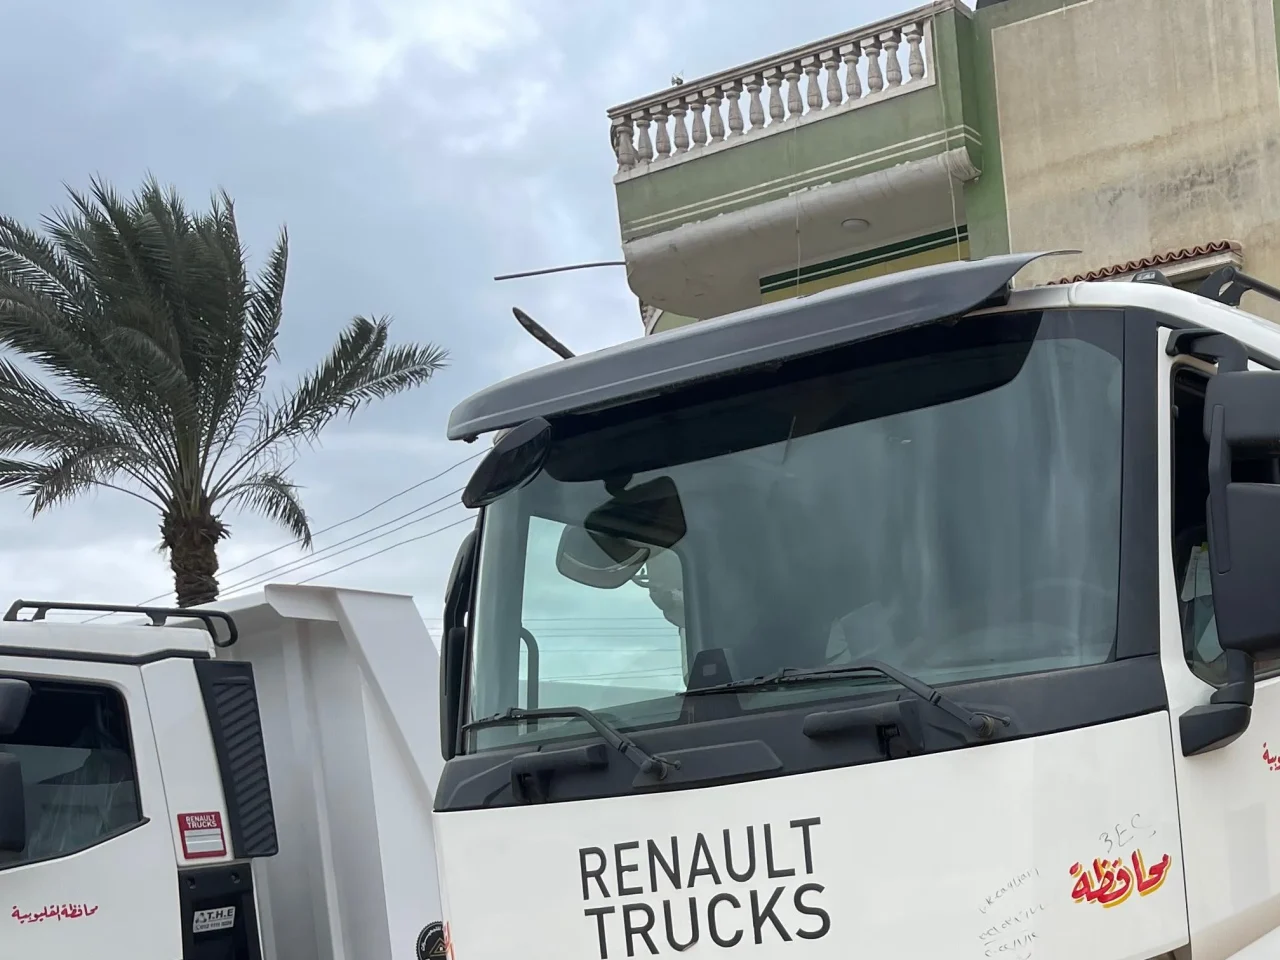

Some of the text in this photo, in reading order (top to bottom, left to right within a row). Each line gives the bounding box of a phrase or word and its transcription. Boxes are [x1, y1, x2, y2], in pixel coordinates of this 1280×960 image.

[185, 814, 216, 824] RENAULT
[187, 820, 218, 829] TRUCKS
[579, 816, 821, 900] RENAULT
[1069, 849, 1172, 909] محافظة
[11, 903, 99, 924] محافظة القليوبية
[207, 909, 234, 920] T.H.E
[584, 882, 831, 960] TRUCKS
